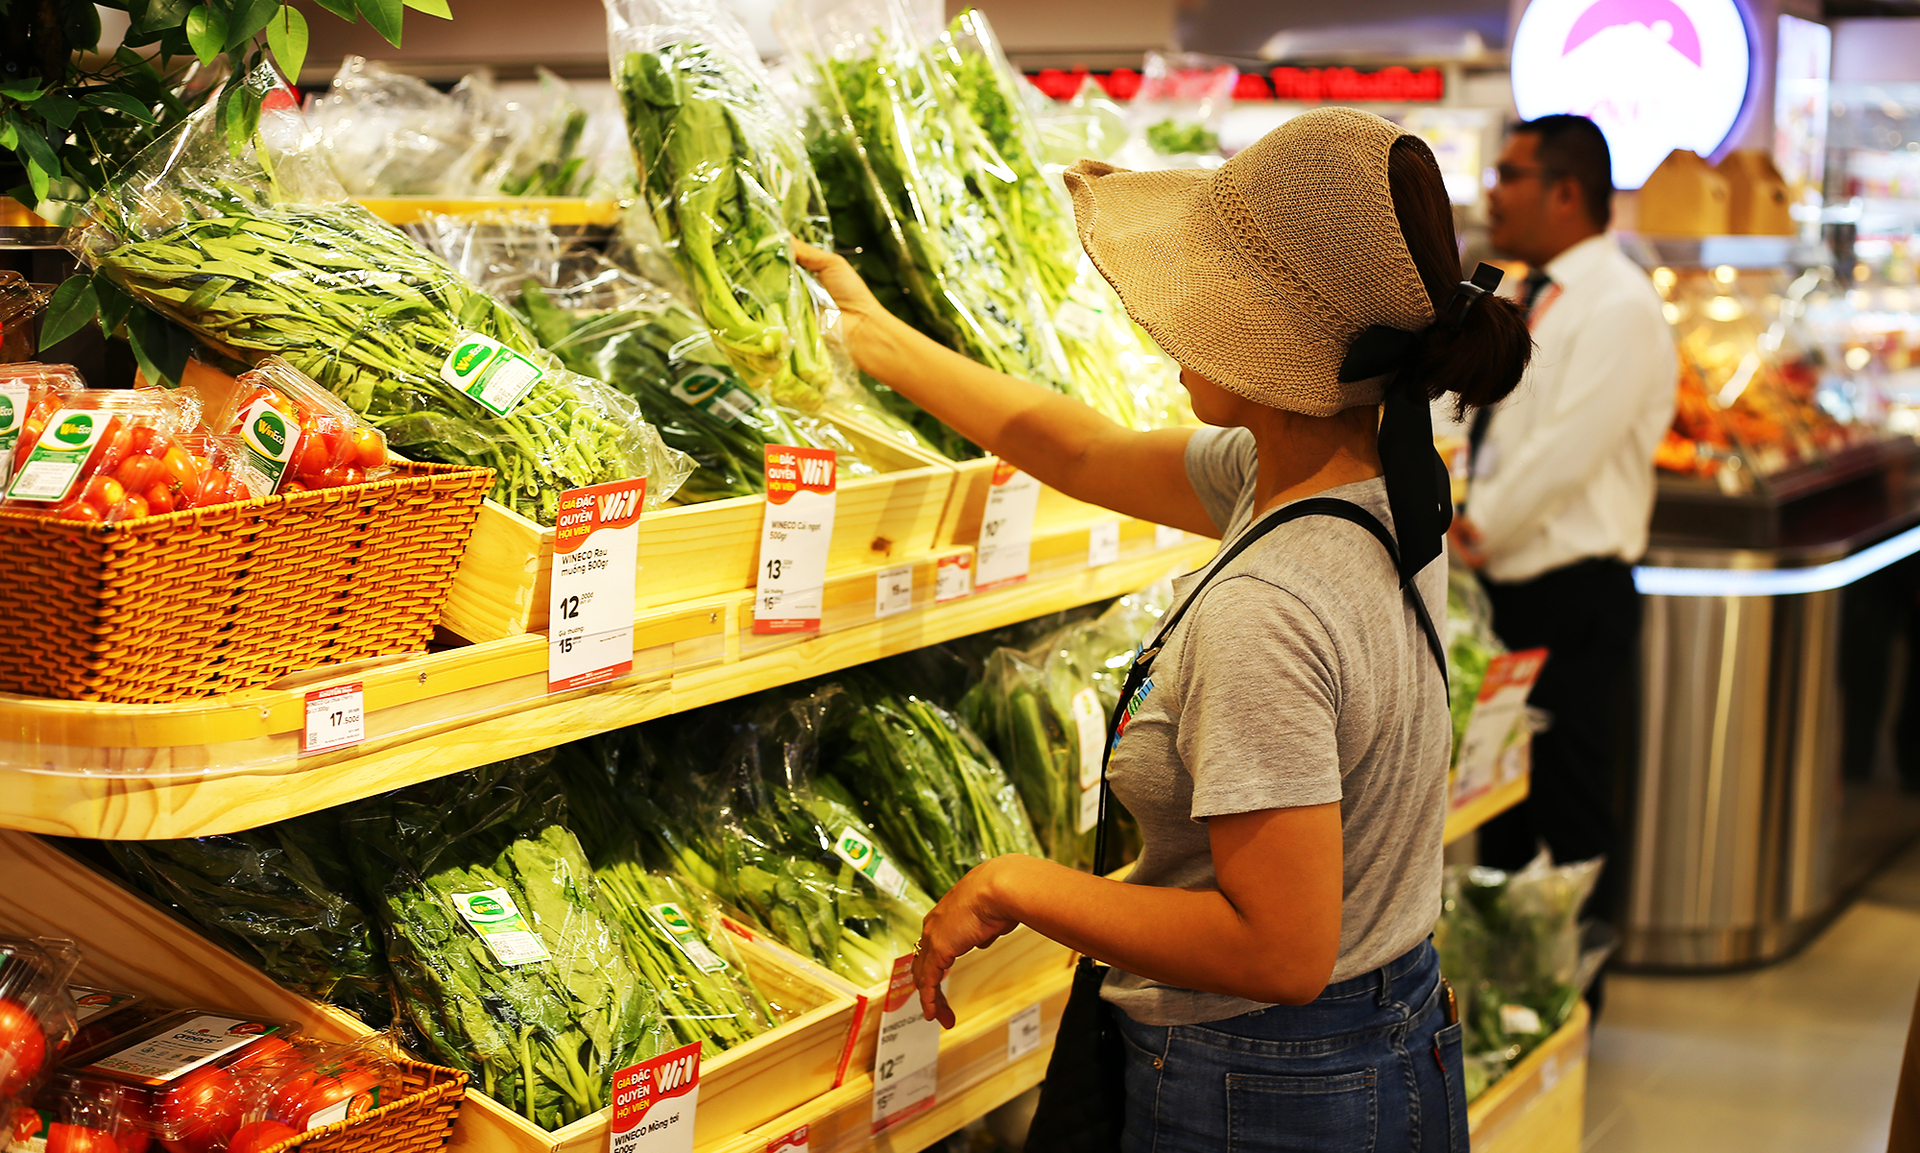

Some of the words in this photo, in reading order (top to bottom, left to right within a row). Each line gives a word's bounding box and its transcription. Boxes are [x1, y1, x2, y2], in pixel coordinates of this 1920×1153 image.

[455, 344, 485, 371] WinEco
[0, 407, 13, 416] Eco
[60, 423, 92, 435] WinEco
[258, 418, 285, 446] WinEco
[562, 497, 577, 511] GIÁ
[576, 493, 596, 510] ĐẶC
[560, 509, 594, 527] QUYỀN
[558, 530, 573, 541] HỘI
[574, 524, 592, 537] VIÊN
[562, 550, 593, 565] WINECO
[594, 548, 608, 559] Rau
[588, 560, 609, 571] 500gr
[766, 559, 782, 579] 13
[560, 595, 580, 620] 12
[559, 637, 573, 654] 15
[330, 711, 343, 727] 17
[617, 1074, 632, 1090] GIÁ
[631, 1068, 651, 1086] ĐẶC
[879, 1059, 894, 1081] 12
[617, 1084, 651, 1107] QUYỀN
[617, 1105, 631, 1119] HỘI
[632, 1098, 650, 1113] VIÊN
[614, 1126, 647, 1147] WINECO
